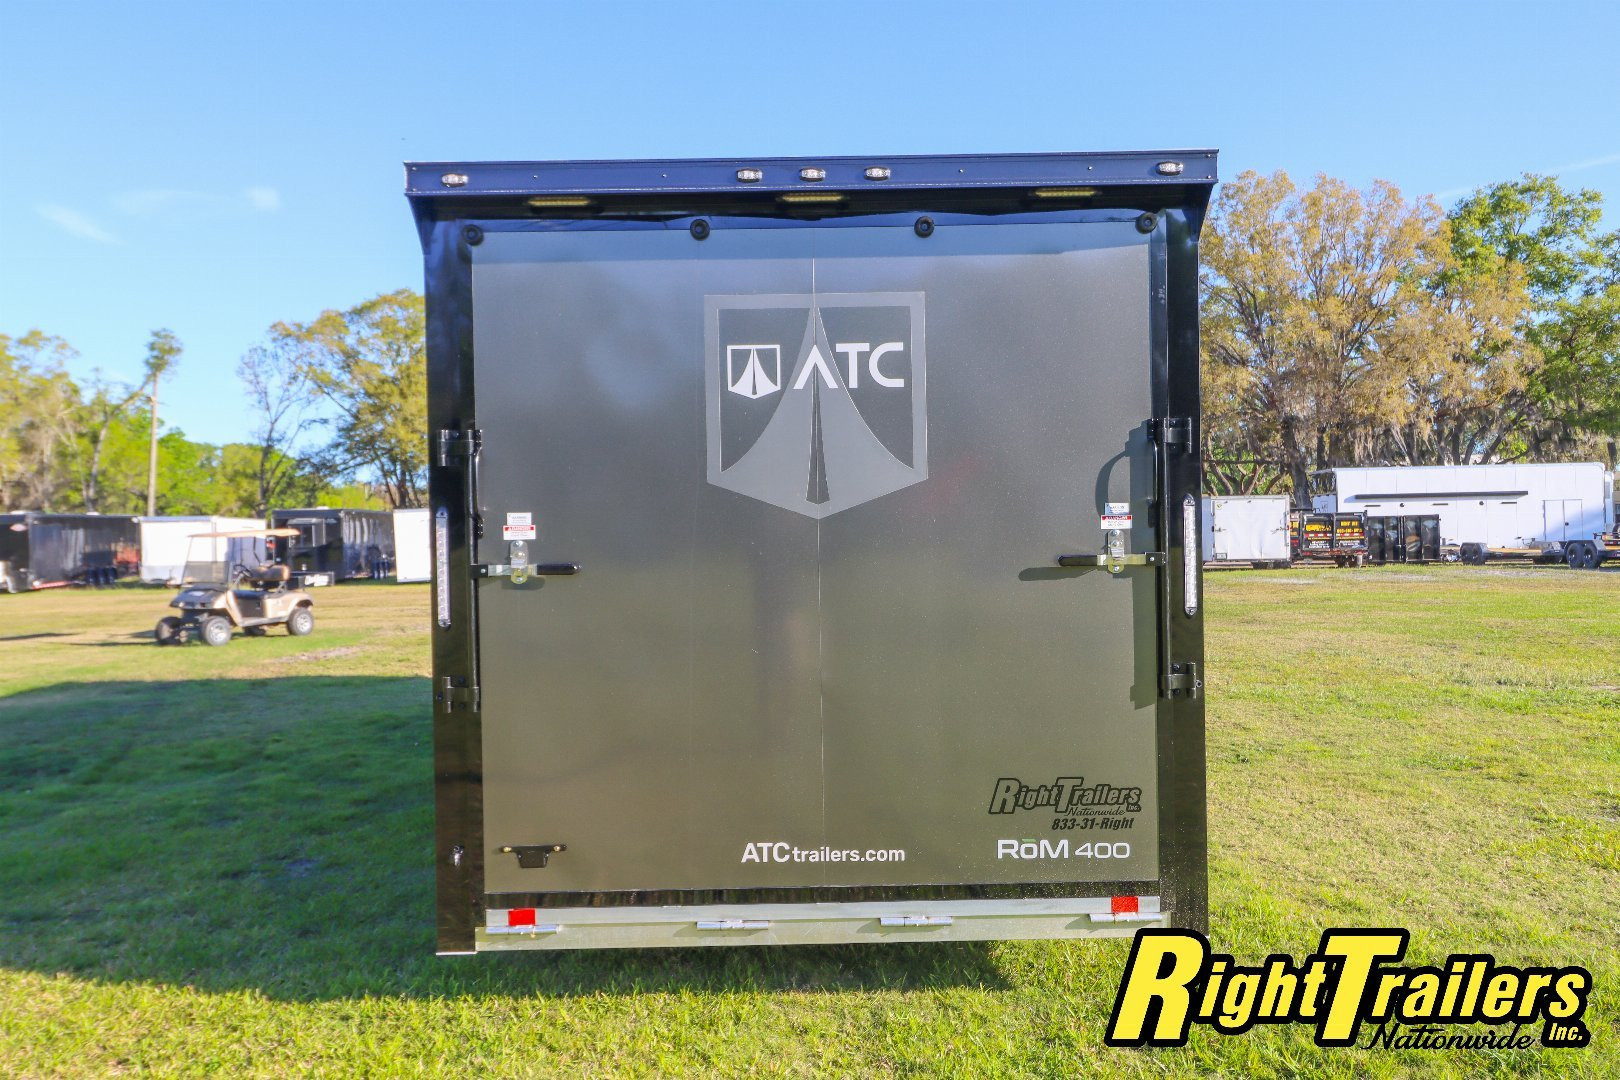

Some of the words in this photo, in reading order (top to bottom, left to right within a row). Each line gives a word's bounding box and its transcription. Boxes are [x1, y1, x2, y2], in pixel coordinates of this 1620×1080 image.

[792, 341, 905, 390] ATC
[1065, 806, 1126, 817] Nationwide
[1052, 817, 1134, 831] 833-31-Right
[741, 841, 906, 863] ATCtrailers.com
[1075, 842, 1131, 859] 400
